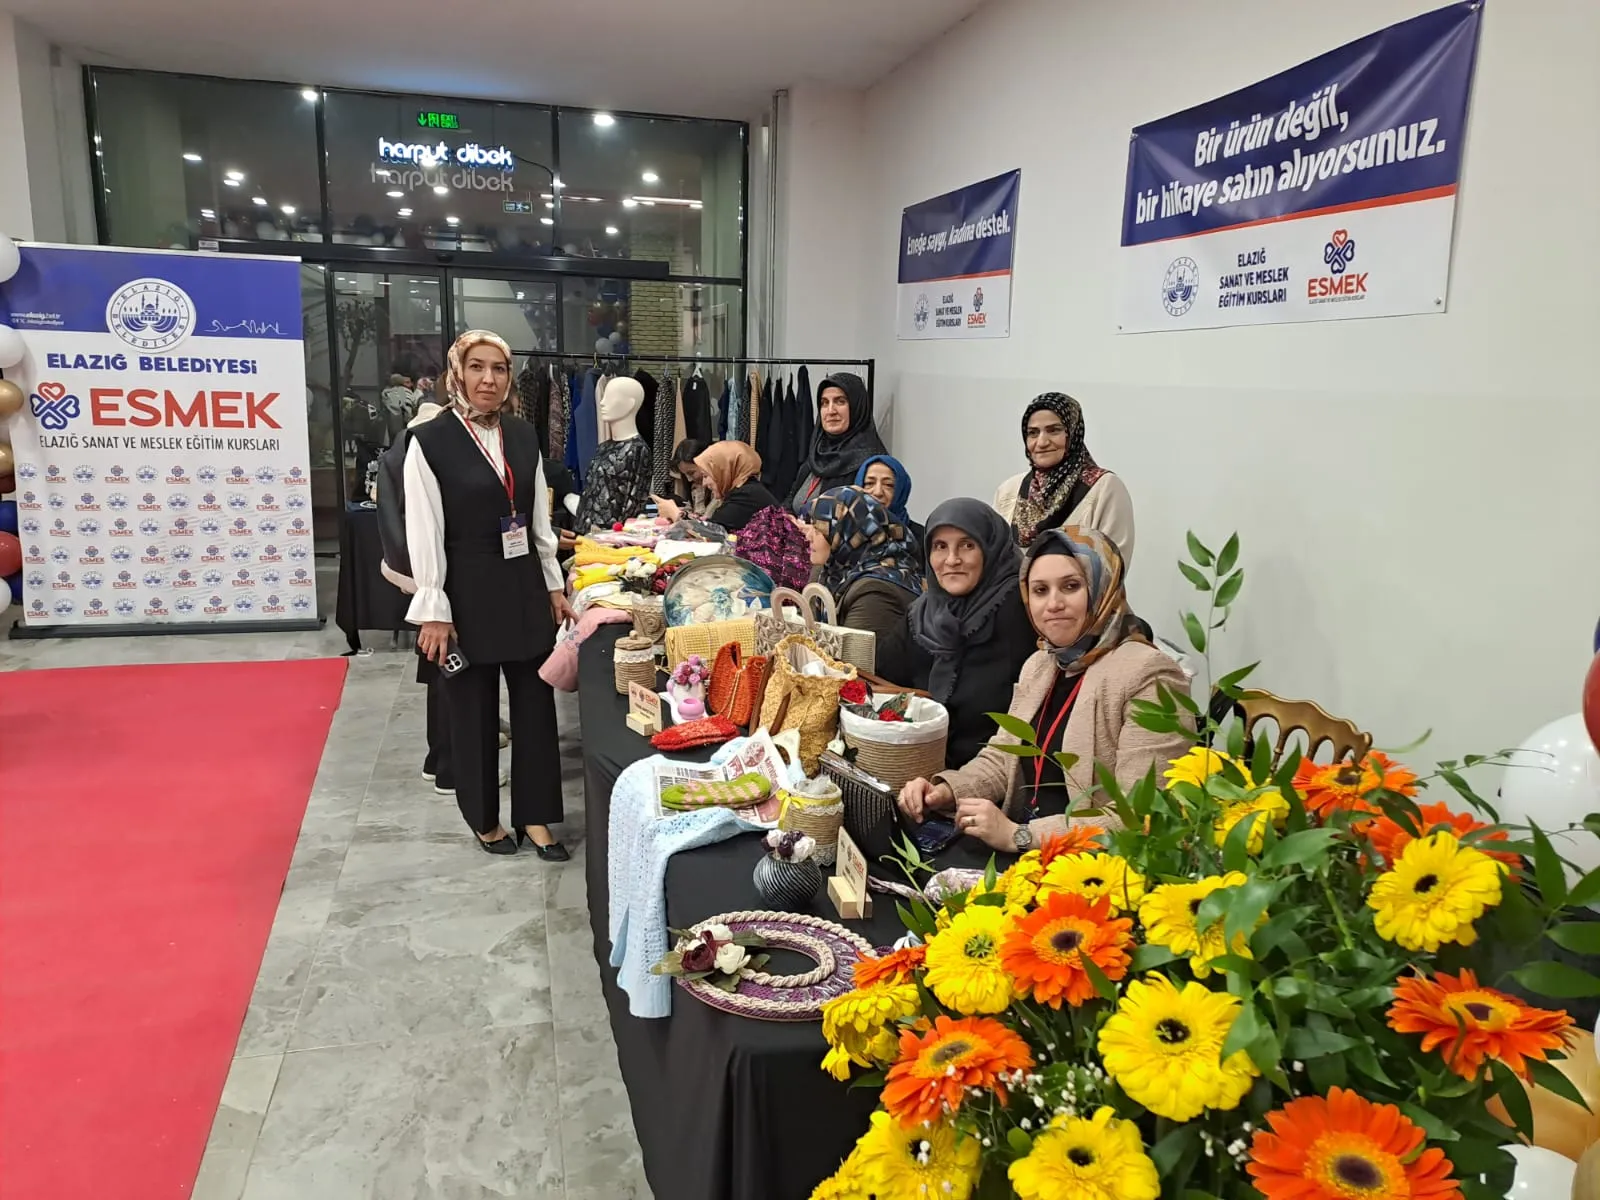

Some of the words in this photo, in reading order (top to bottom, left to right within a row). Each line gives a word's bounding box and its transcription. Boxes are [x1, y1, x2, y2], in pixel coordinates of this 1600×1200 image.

[1194, 130, 1223, 168] Bir
[1223, 113, 1275, 160] ürün
[1274, 82, 1349, 142] değil,
[378, 136, 449, 165] harput
[456, 142, 513, 166] dibek
[1135, 190, 1160, 225] bir
[1160, 177, 1217, 218] hikaye
[1218, 163, 1275, 206] satın
[1277, 117, 1447, 193] alıyorsunuz.
[975, 209, 1011, 240] destek.
[1237, 247, 1266, 268] ELAZIĞ
[1219, 273, 1243, 290] SANAT
[1244, 272, 1255, 287] VE
[1256, 266, 1290, 285] MESLEK
[1307, 271, 1369, 298] ESMEK
[1218, 290, 1245, 308] EĞİTİM
[1246, 287, 1288, 306] KURSLARI
[47, 353, 128, 371] ELAZIĞ
[90, 388, 282, 429] ESMEK
[39, 433, 79, 449] ELAZIĞ
[82, 435, 120, 449] SANAT
[122, 436, 137, 449] VE
[140, 437, 183, 450] MESLEK
[186, 434, 224, 450] EĞİTİM
[227, 438, 280, 451] KURSLARI
